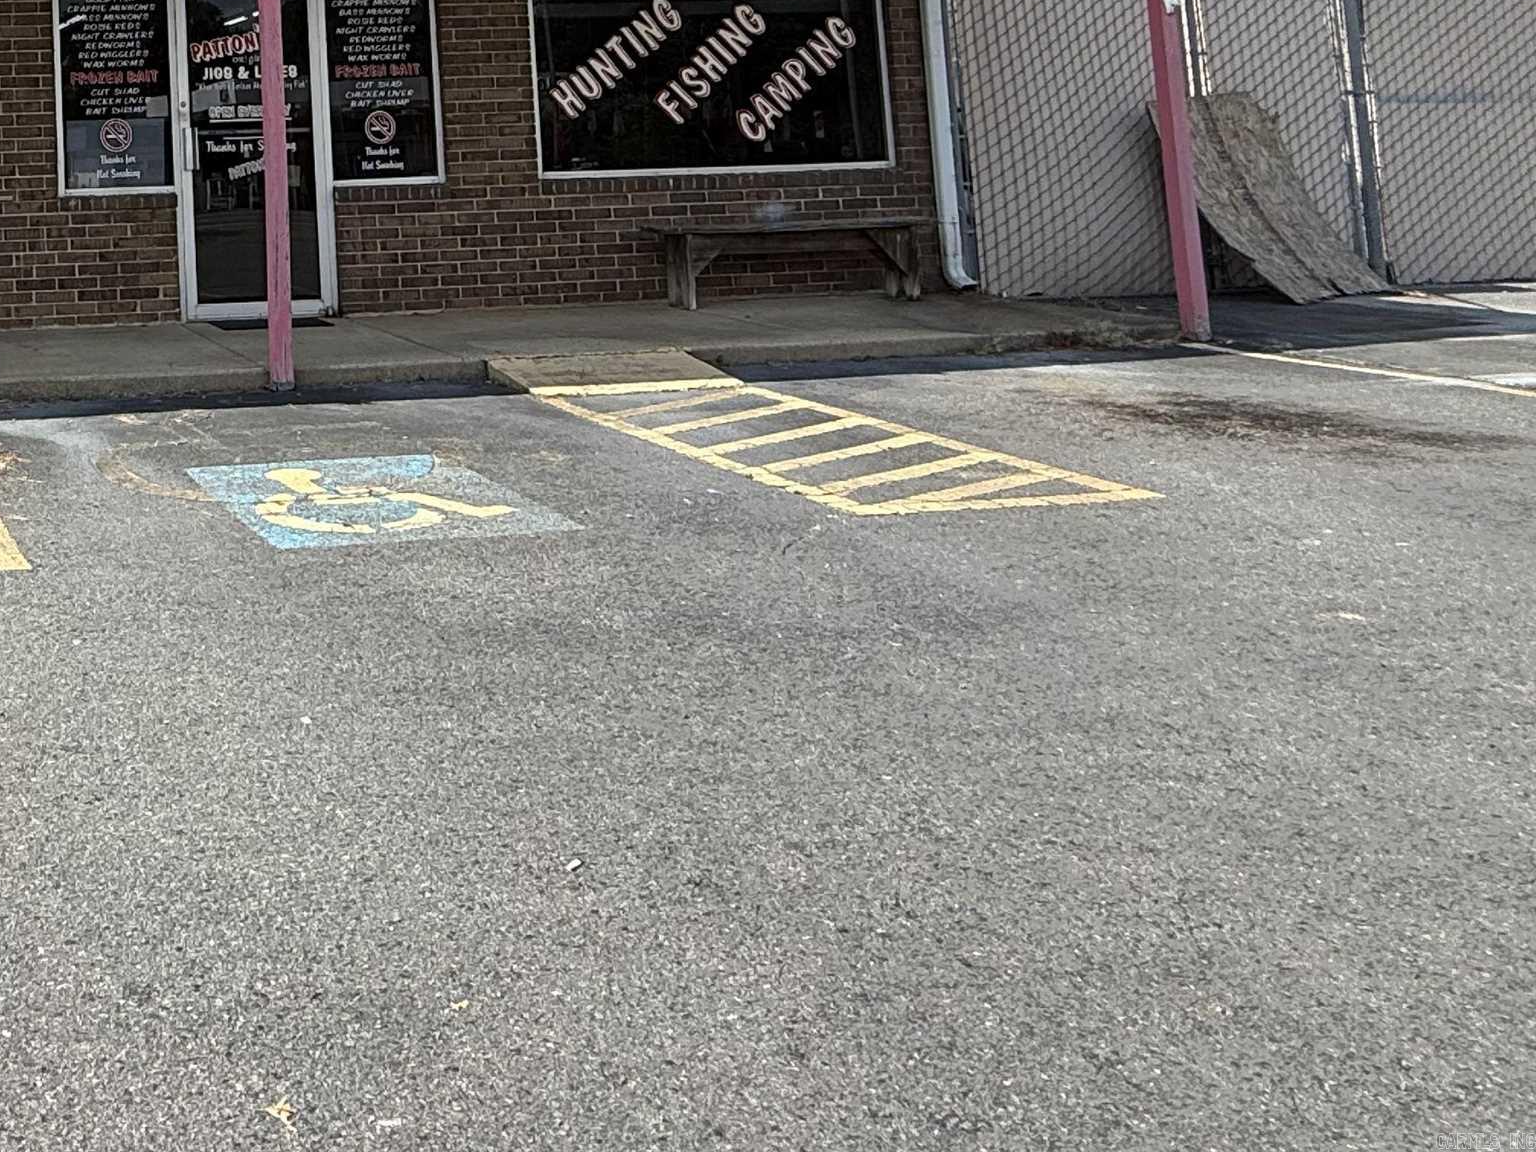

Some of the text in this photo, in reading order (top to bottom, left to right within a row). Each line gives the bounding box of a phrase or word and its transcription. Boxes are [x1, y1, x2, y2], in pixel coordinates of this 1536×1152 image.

[190, 23, 260, 63] PATTON'
[389, 62, 421, 77] BAIT
[654, 3, 767, 125] FISHING
[69, 69, 159, 86] FROZEN BAIT
[202, 65, 298, 81] JIGS & LES
[735, 16, 857, 143] CAMPING
[205, 140, 237, 153] Thanks
[239, 140, 254, 153] for
[365, 146, 388, 157] Thanks
[100, 154, 124, 165] Thanks
[375, 160, 405, 171] Smoking
[111, 169, 141, 180] Smoking
